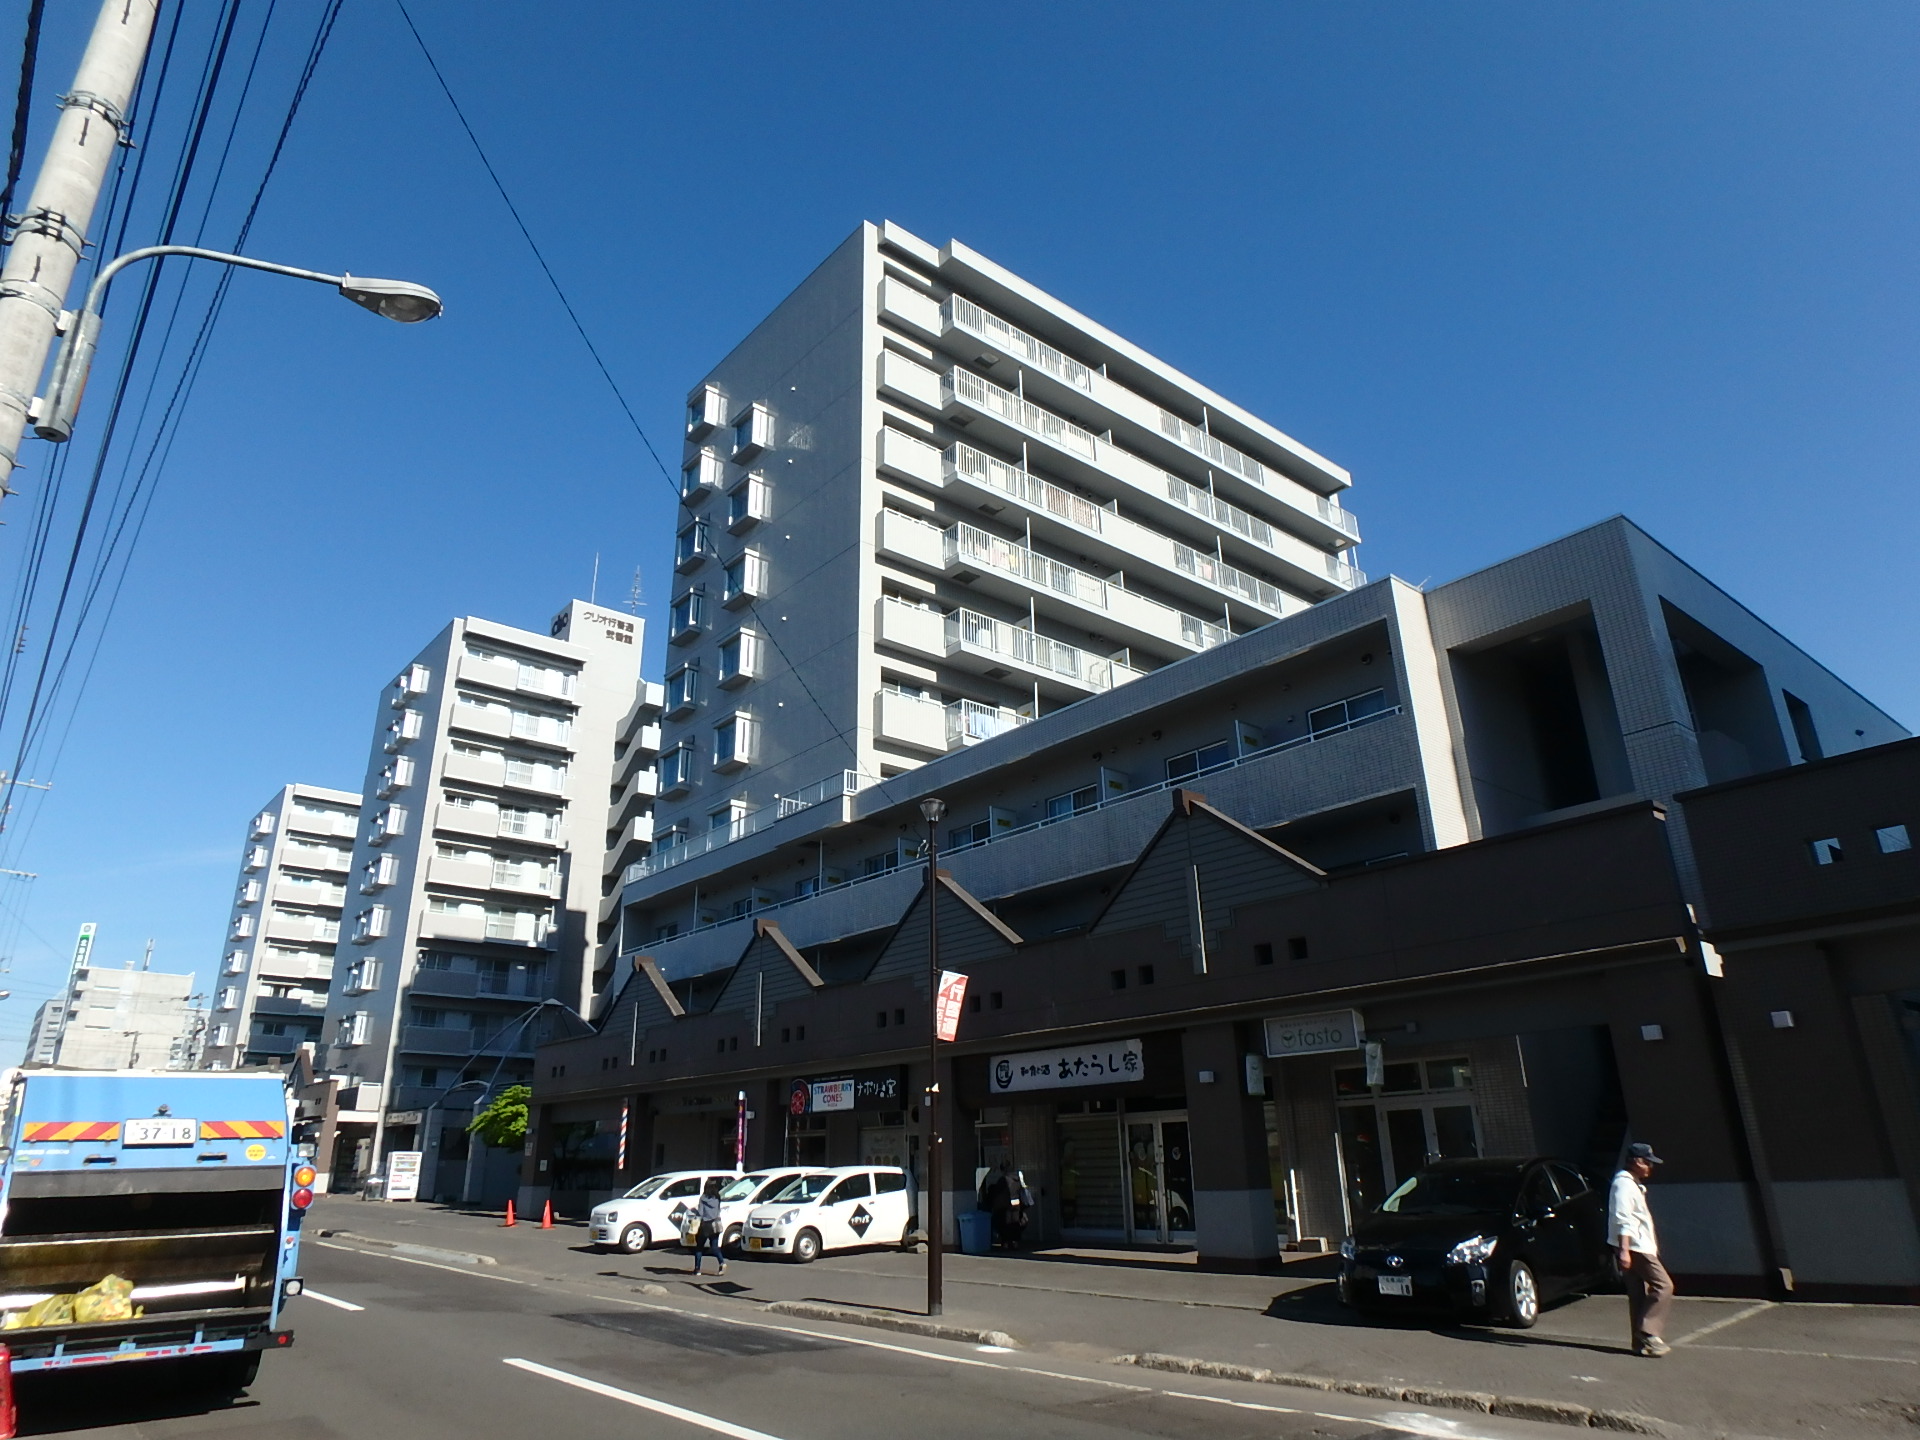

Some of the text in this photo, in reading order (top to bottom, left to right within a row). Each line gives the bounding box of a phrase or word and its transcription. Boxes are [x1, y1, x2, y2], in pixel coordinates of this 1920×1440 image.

[1298, 1027, 1342, 1047] fasto
[1058, 1050, 1139, 1079] あたらし家
[814, 1082, 853, 1096] STRAWBERRY
[822, 1094, 843, 1104] CONES
[139, 1127, 192, 1140] 37-18
